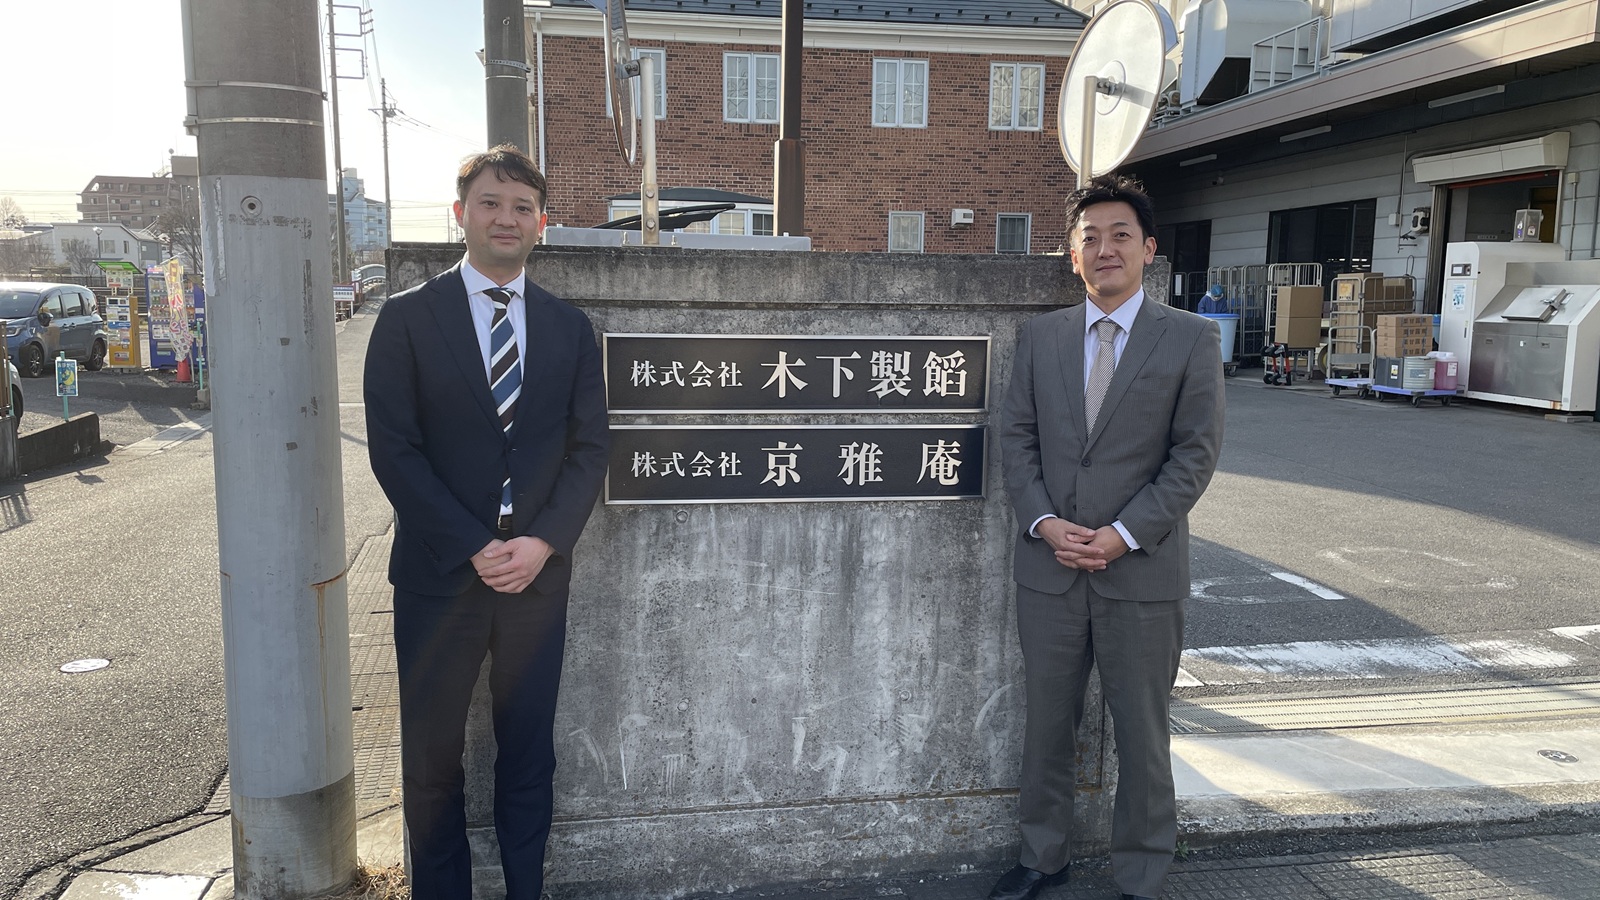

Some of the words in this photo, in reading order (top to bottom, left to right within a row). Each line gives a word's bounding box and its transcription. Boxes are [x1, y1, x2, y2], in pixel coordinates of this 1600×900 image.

[629, 359, 743, 388] 株式会社
[630, 450, 743, 478] 株式会社
